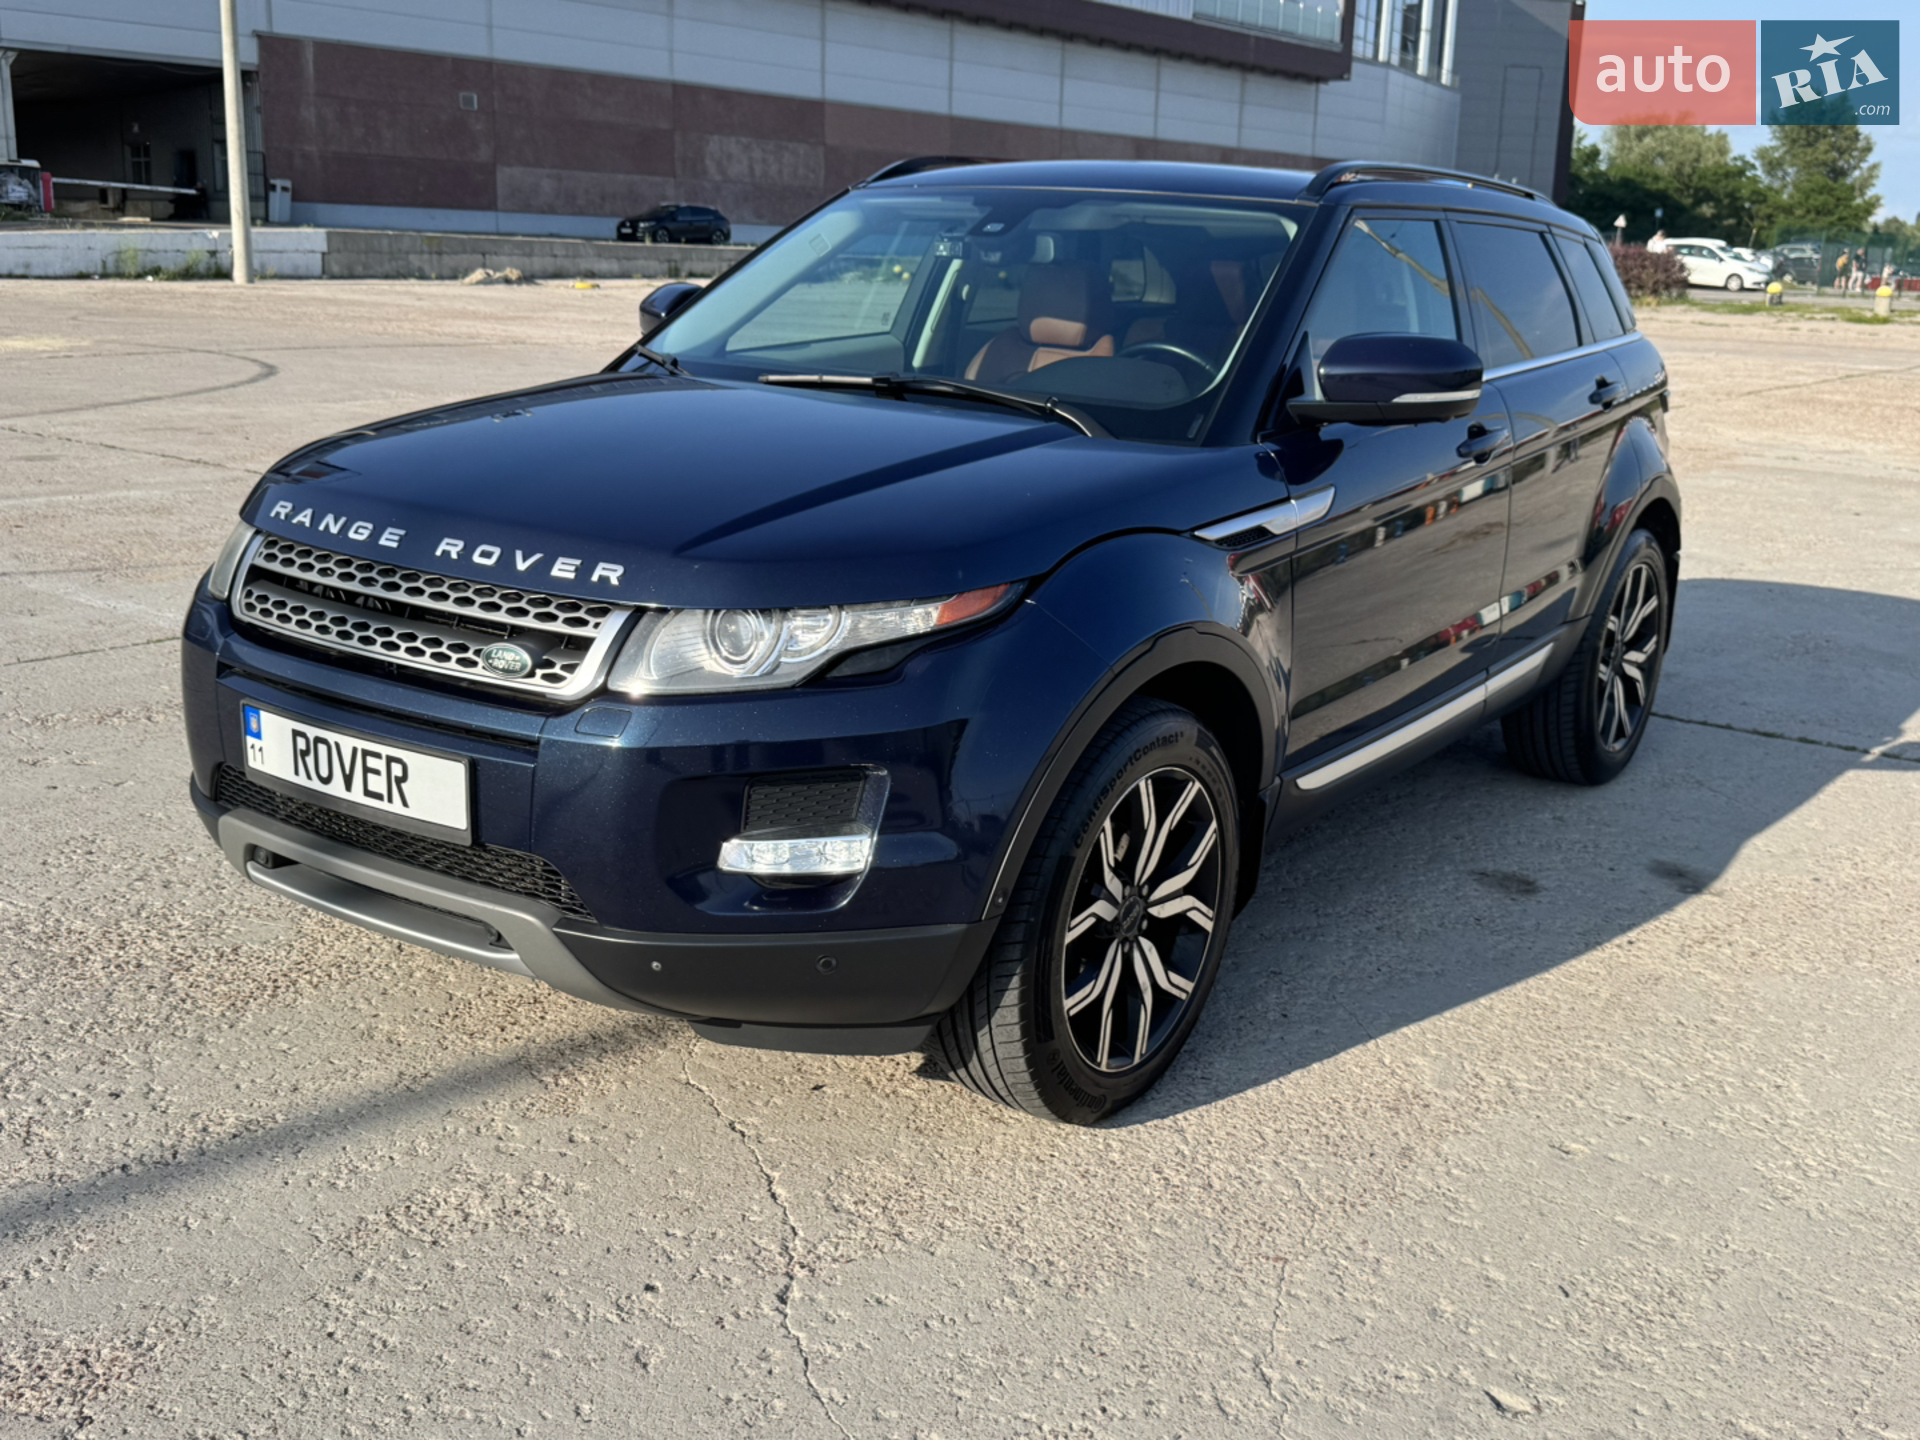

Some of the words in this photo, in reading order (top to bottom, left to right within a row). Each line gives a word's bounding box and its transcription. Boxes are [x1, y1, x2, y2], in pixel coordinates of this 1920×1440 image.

[269, 500, 407, 548] RANGE
[434, 537, 625, 585] ROVER
[249, 743, 265, 765] 11
[291, 727, 410, 808] ROVER
